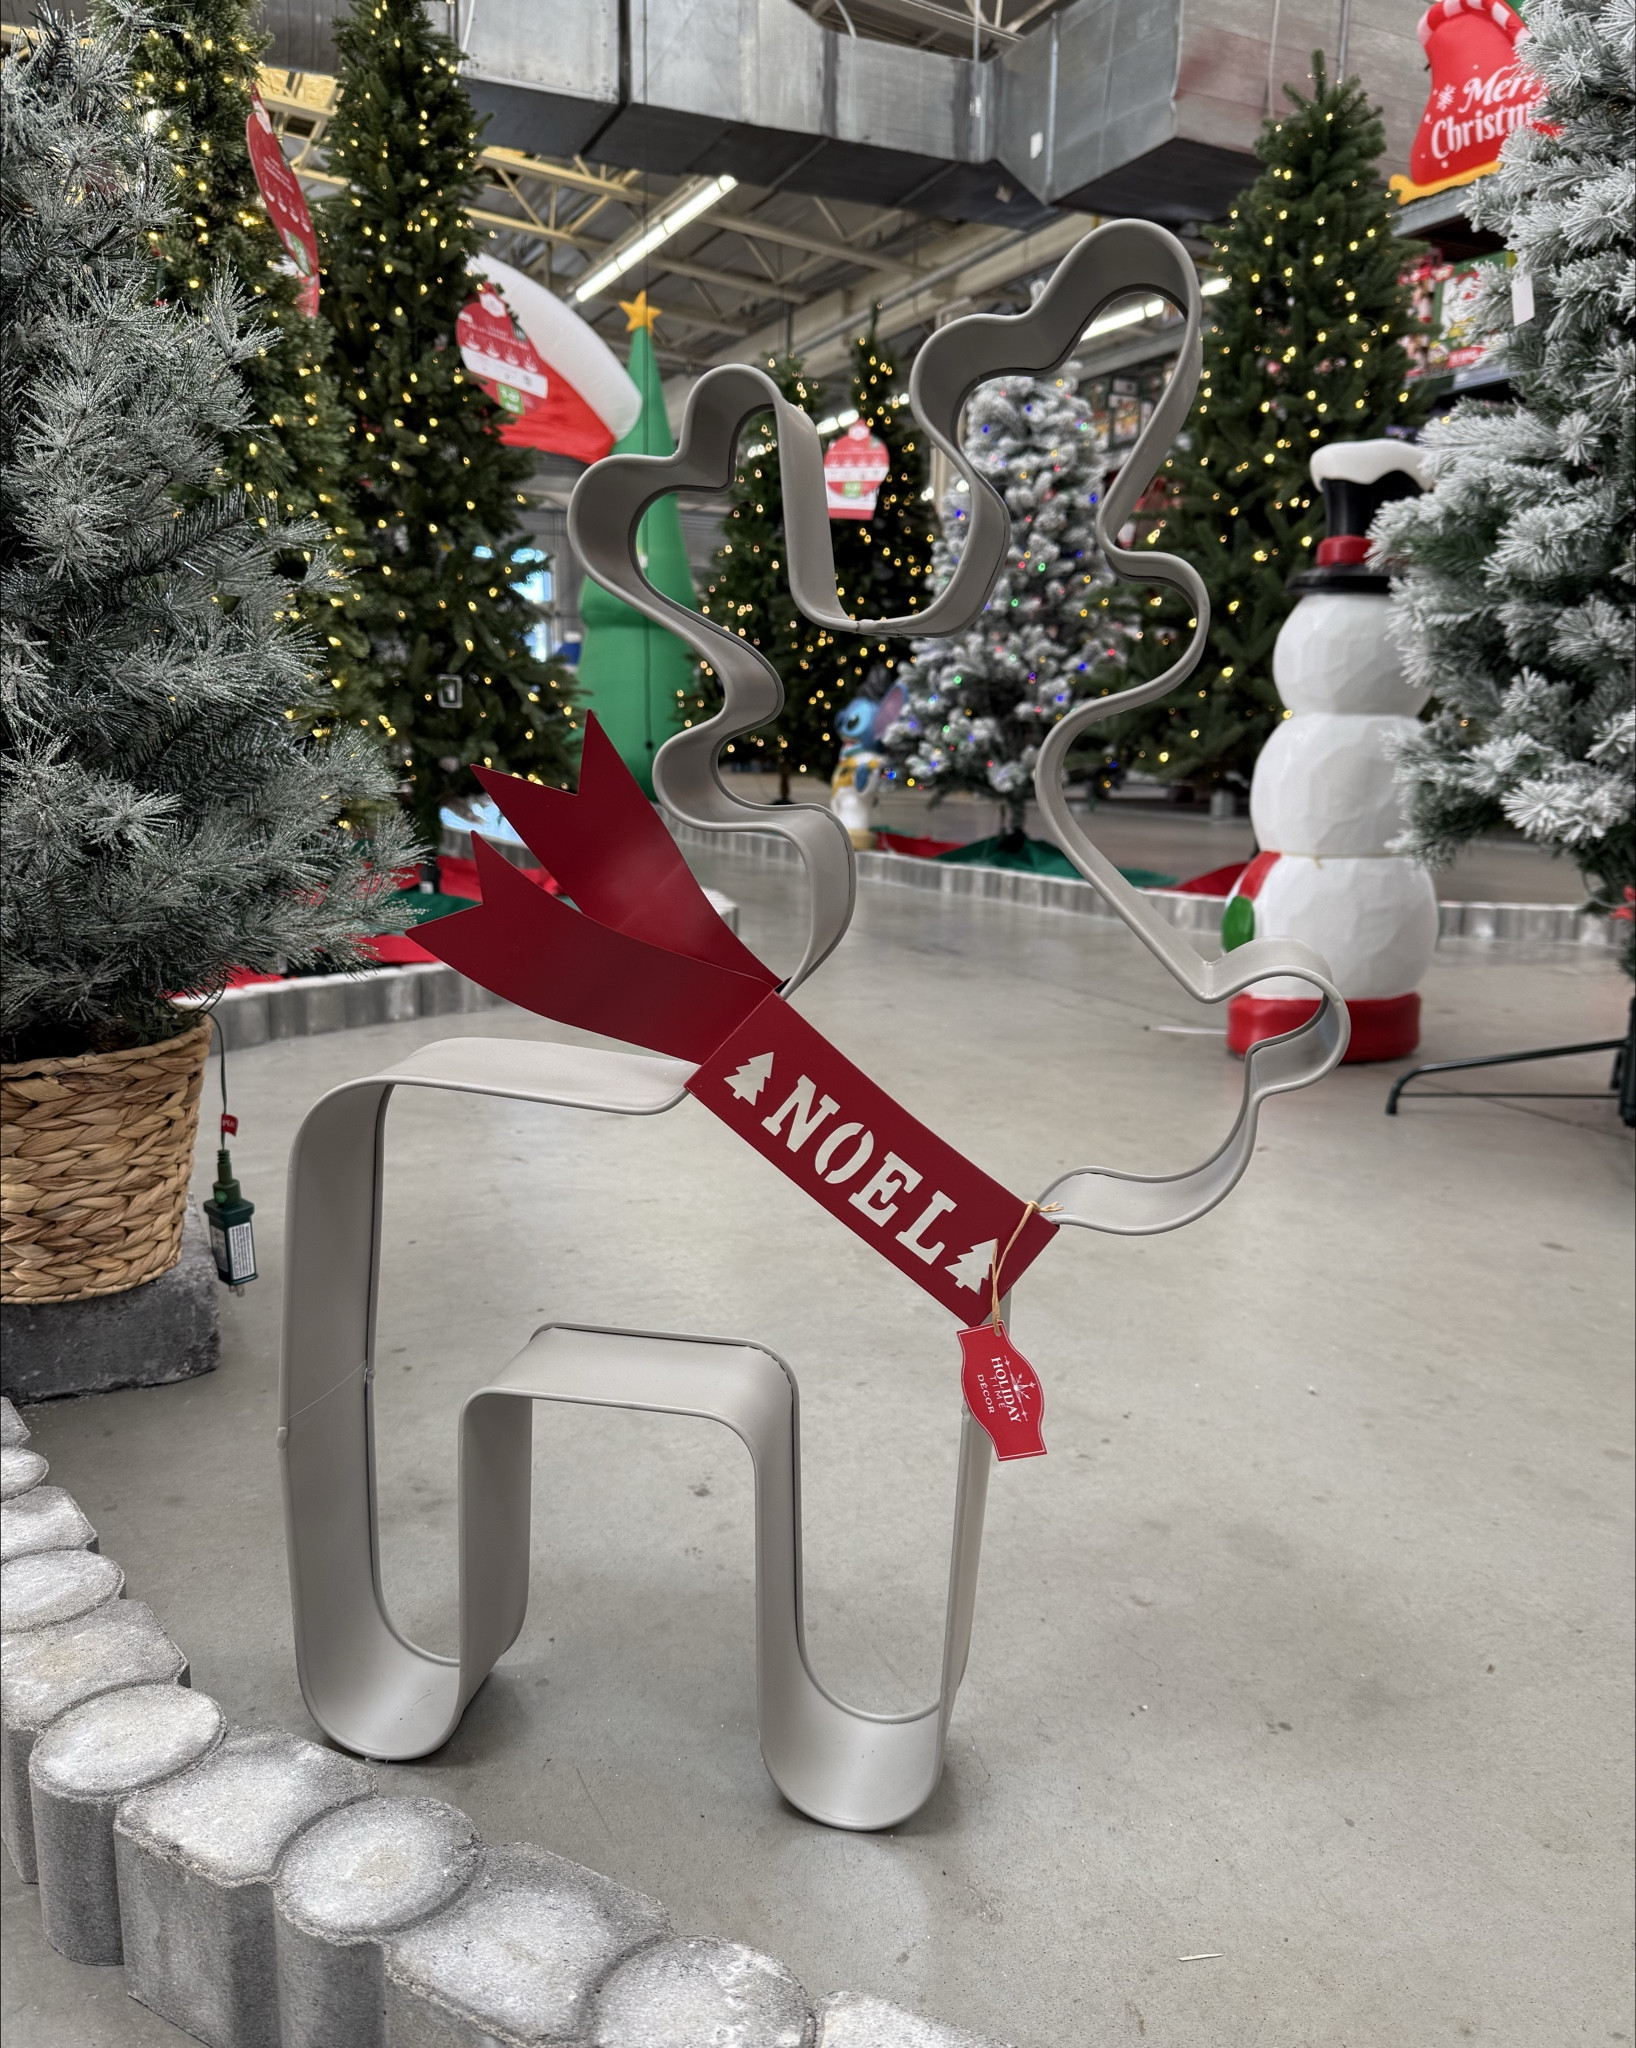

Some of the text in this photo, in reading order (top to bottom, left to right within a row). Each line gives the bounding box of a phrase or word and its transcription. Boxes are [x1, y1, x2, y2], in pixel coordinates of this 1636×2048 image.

[1430, 101, 1537, 160] Christm
[760, 1073, 958, 1266] NOEL
[990, 1375, 1006, 1408] TIME
[991, 1356, 1022, 1422] HOLIDAY
